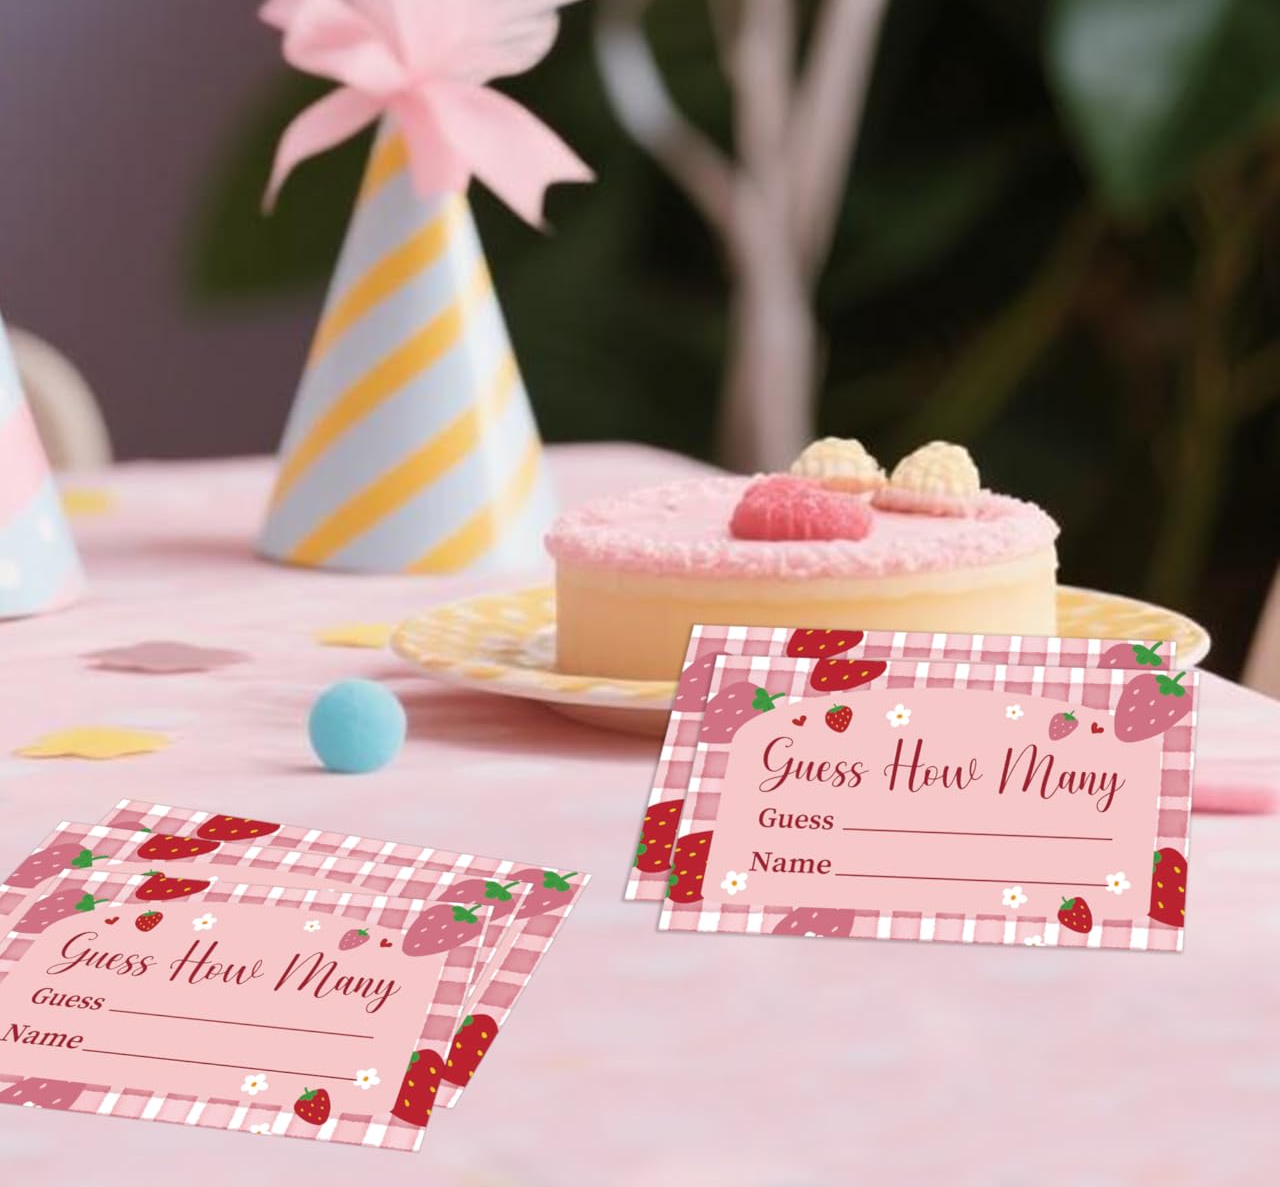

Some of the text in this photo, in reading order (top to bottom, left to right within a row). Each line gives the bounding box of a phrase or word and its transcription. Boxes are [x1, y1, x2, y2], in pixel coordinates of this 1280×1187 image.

[758, 736, 1126, 814] Guess How Many
[758, 807, 835, 831] Guess
[748, 851, 833, 876] Name
[46, 931, 402, 1014] Guess How Many
[31, 987, 106, 1011] Guess
